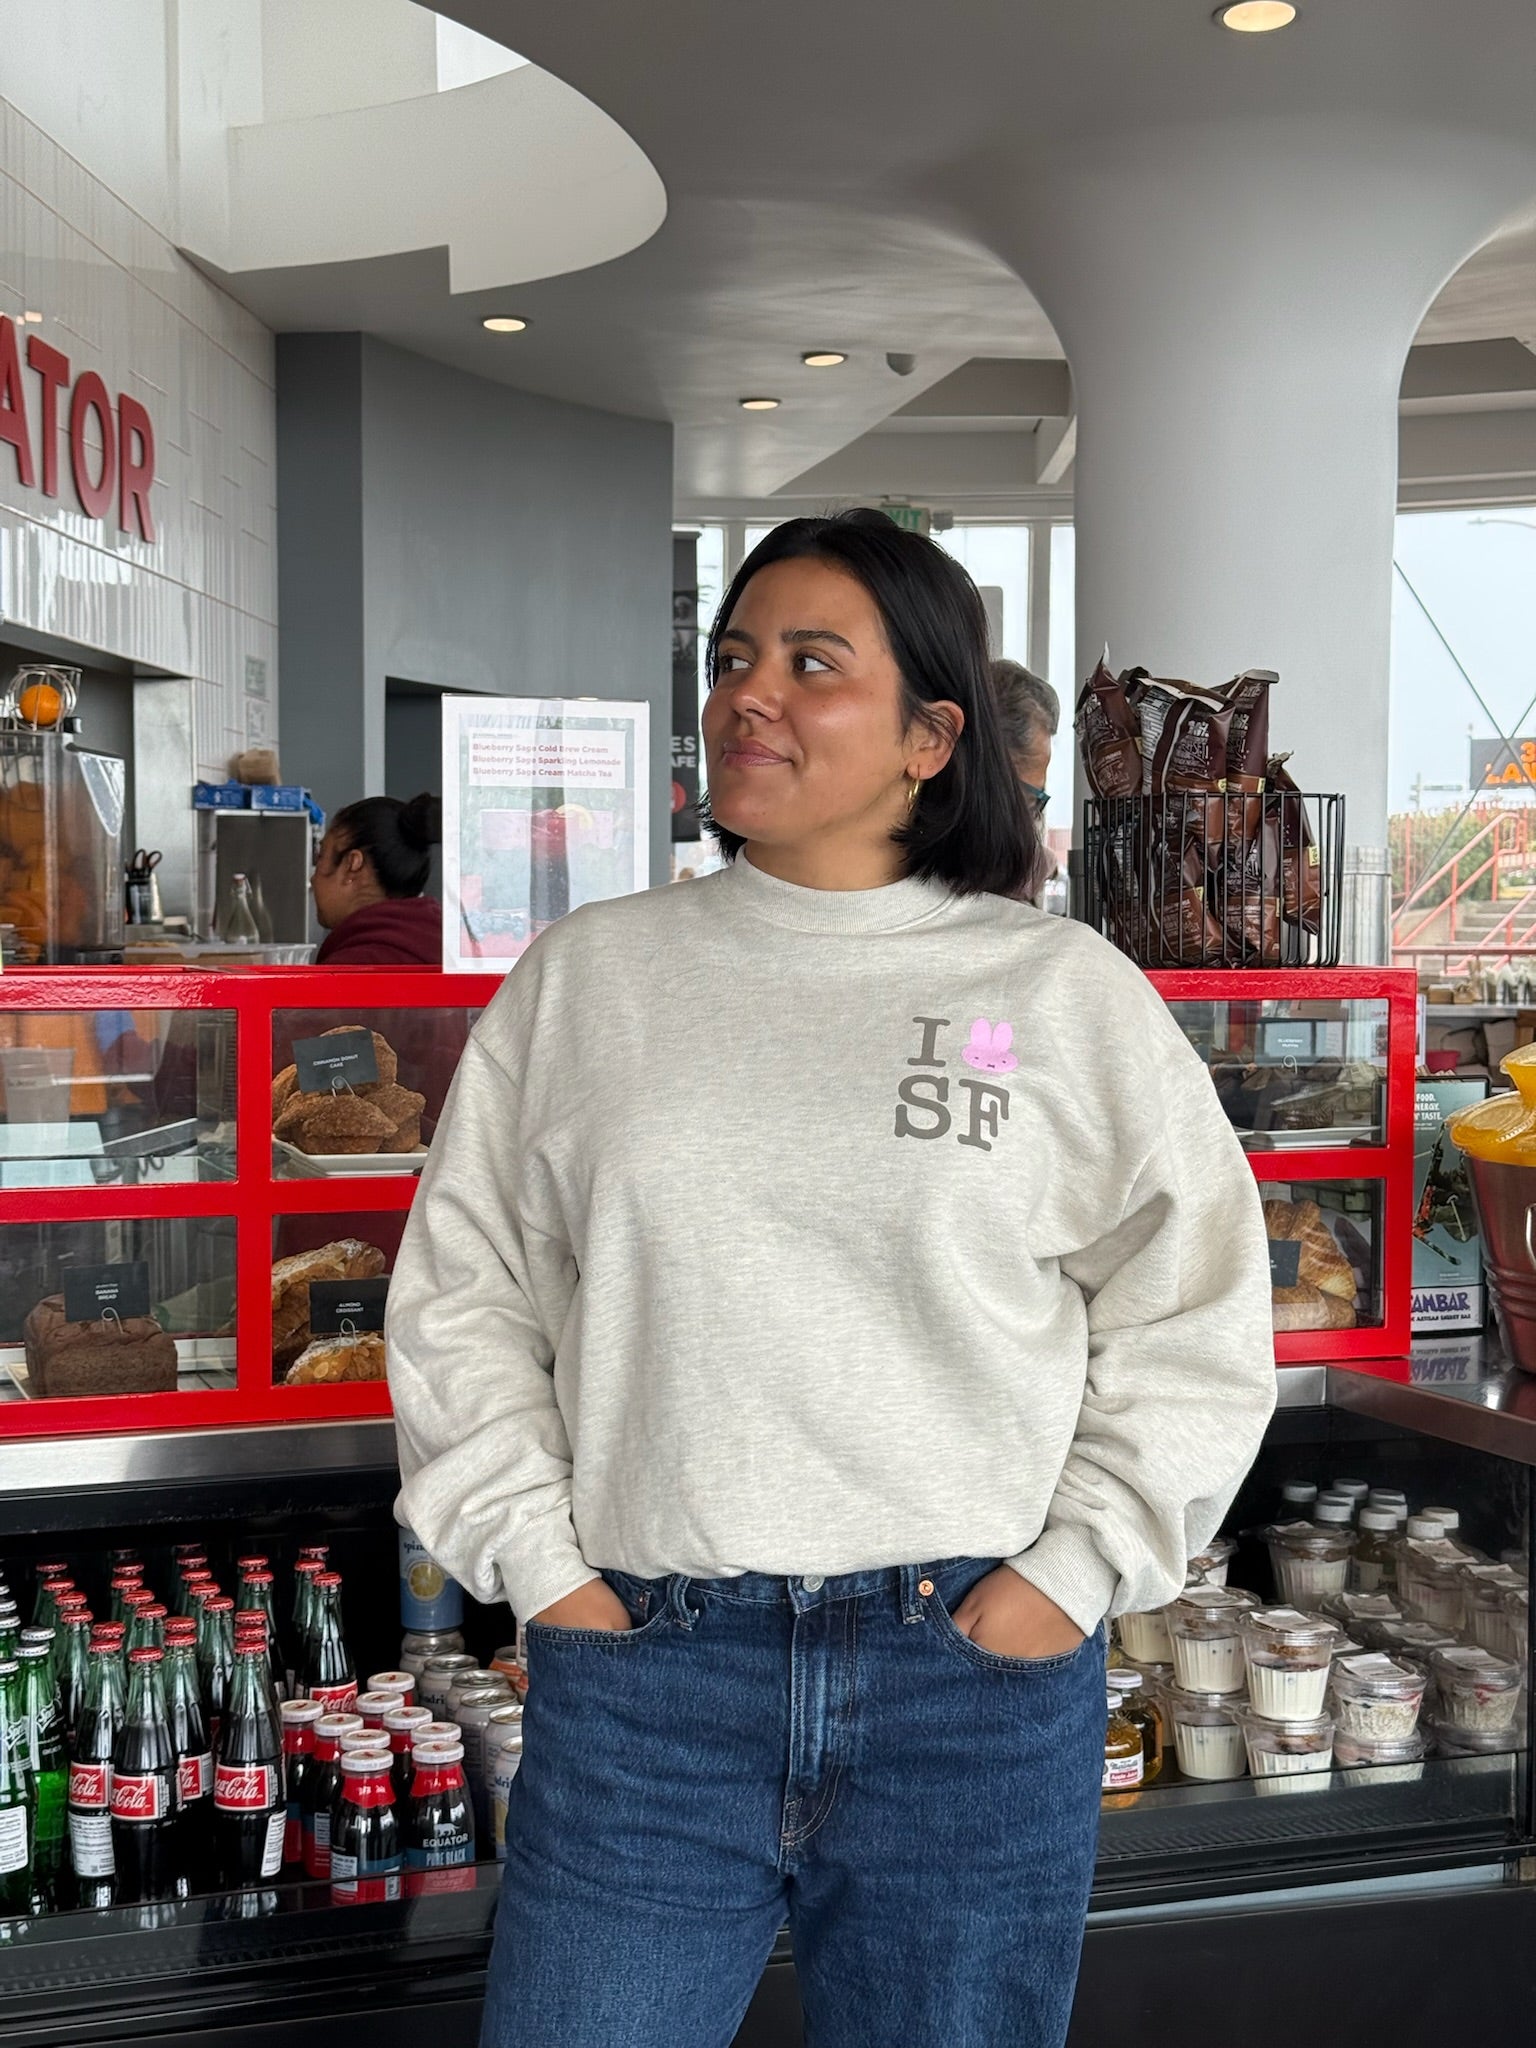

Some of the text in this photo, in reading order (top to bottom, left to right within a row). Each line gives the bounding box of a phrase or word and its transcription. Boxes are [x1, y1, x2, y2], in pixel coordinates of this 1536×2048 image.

[472, 743, 609, 755] Blueberry Sage Cold Brew Cream
[472, 755, 622, 766] Blueberry Sage Sparkling Lemonade
[472, 767, 514, 777] Blueberry
[515, 768, 537, 777] Sage
[538, 768, 566, 777] Cream
[598, 770, 613, 778] Tea
[907, 1016, 951, 1068] I
[894, 1074, 1010, 1152] SF
[1411, 1291, 1471, 1313] AMBAR
[422, 1833, 469, 1848] EQUATOR
